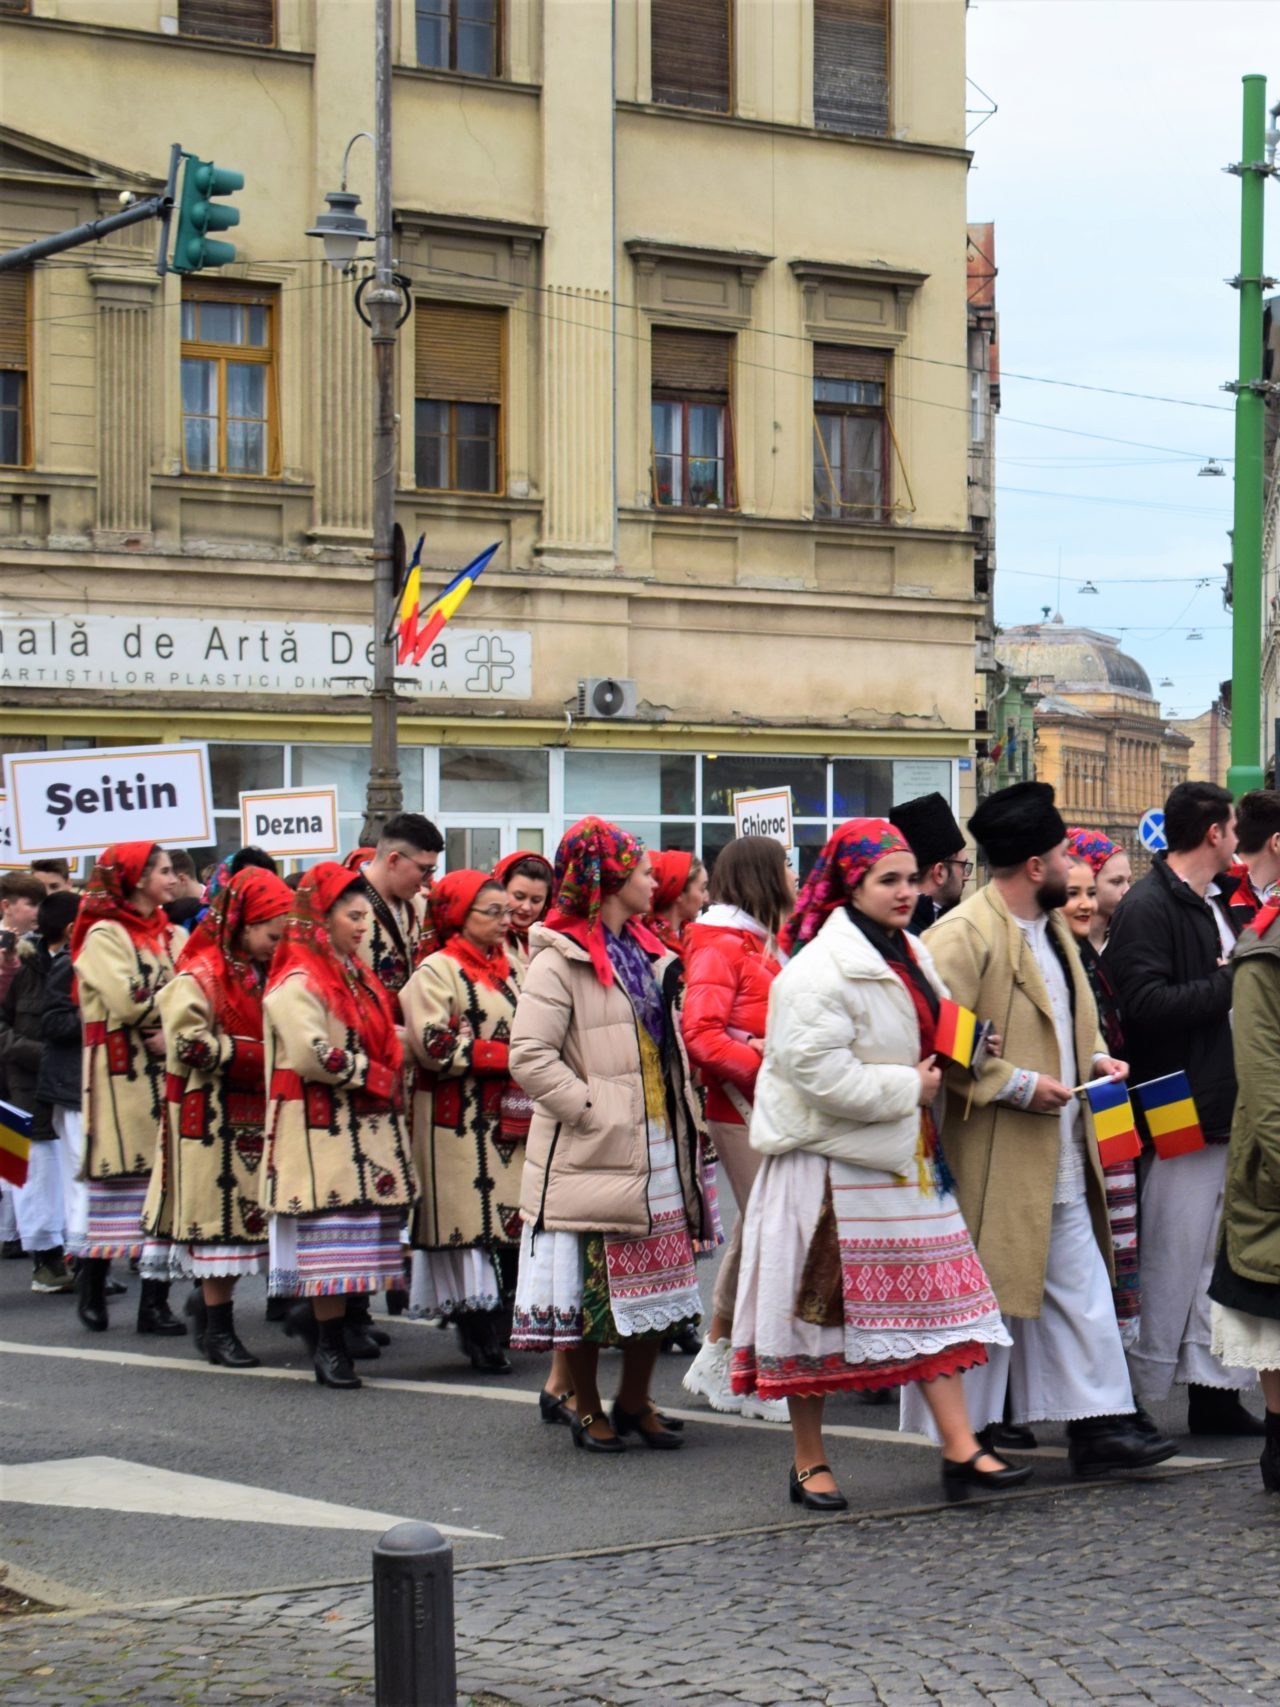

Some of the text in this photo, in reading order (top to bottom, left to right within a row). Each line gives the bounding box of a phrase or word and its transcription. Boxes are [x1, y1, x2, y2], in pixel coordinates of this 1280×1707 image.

[0, 620, 89, 657] ală
[123, 624, 174, 659] de
[204, 626, 298, 663] Artă
[170, 672, 280, 687] PLASTICI
[295, 676, 332, 689] DIN
[46, 773, 177, 831] Șeitin
[256, 814, 323, 836] Dezna
